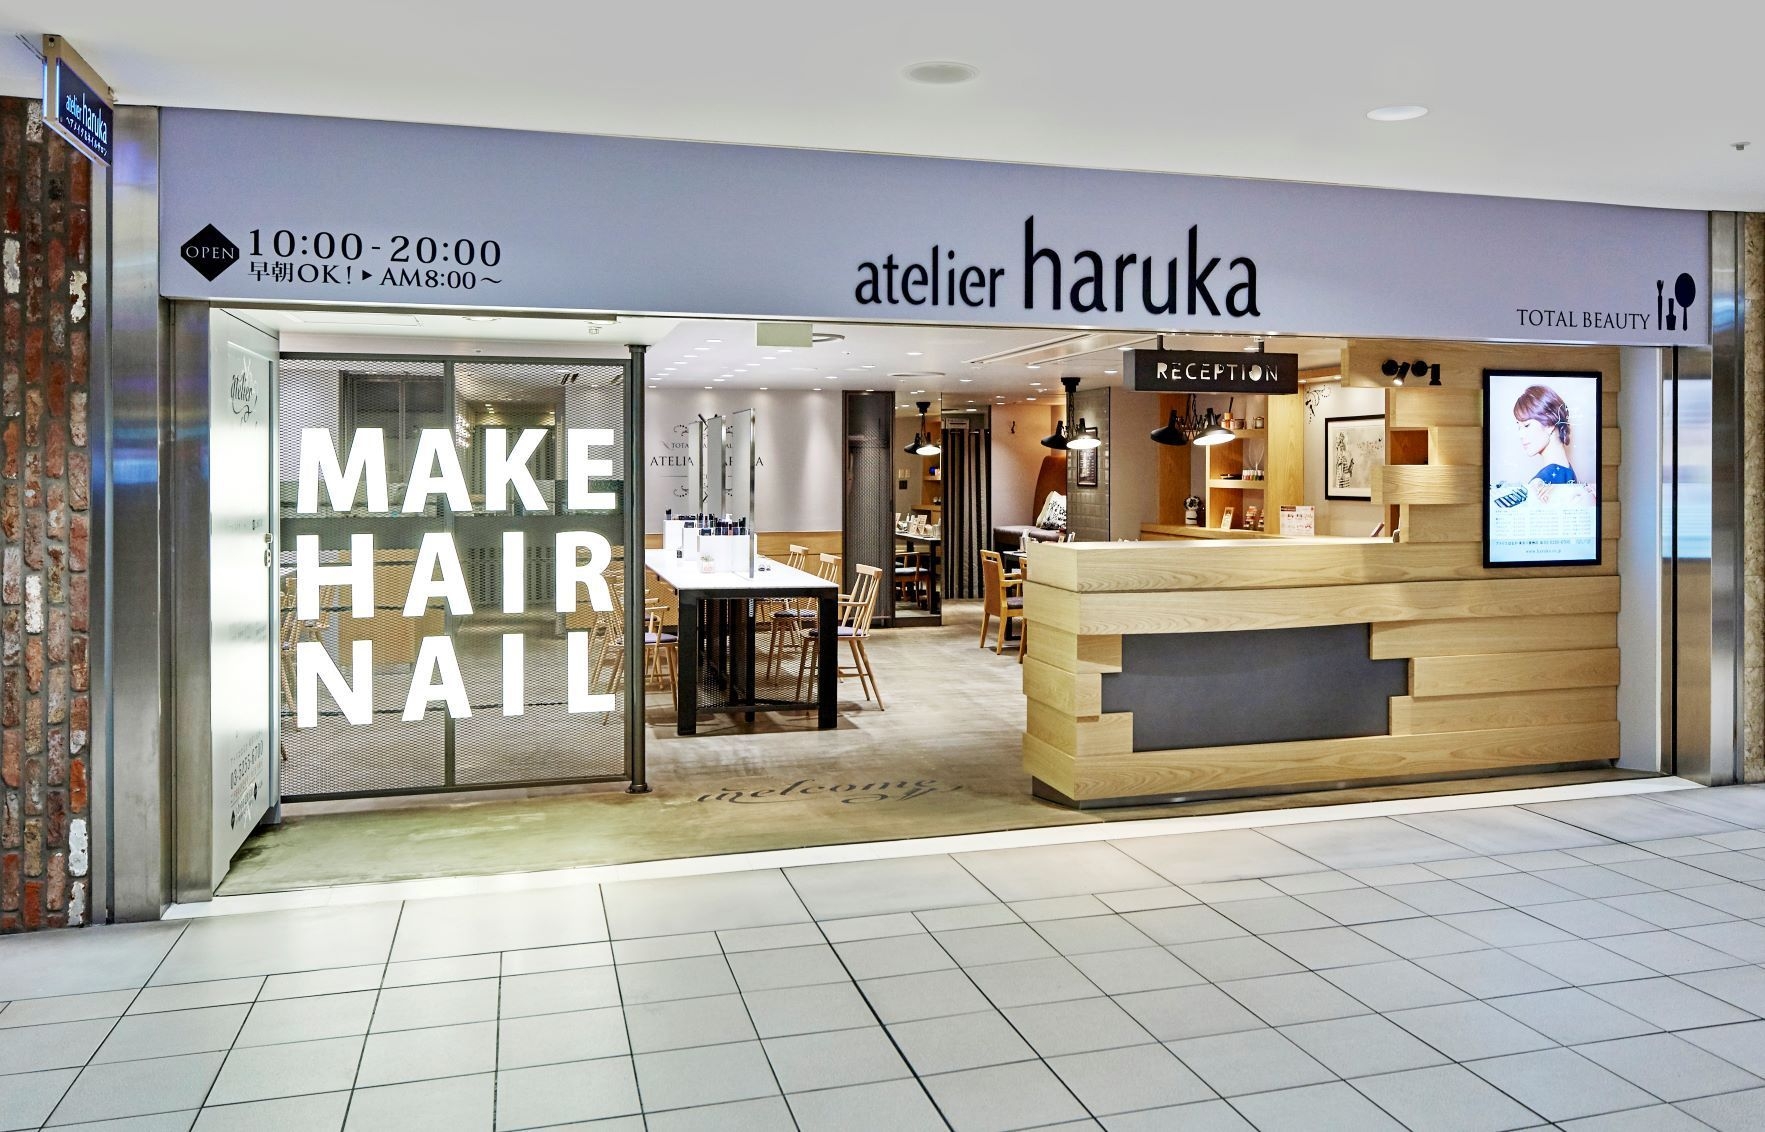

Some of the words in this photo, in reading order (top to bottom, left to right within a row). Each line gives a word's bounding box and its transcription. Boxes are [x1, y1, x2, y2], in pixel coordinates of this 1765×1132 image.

[66, 94, 82, 121] atelier
[82, 92, 107, 144] haruka
[186, 245, 235, 260] OPEN
[854, 244, 1005, 308] atelier
[1024, 214, 1261, 318] haruka
[1516, 308, 1578, 328] TOTAL
[1582, 311, 1651, 330] BEAUTY
[1156, 361, 1279, 382] RECEPTION
[296, 427, 617, 514] MAKE
[296, 530, 615, 621] HAIR
[296, 631, 617, 729] NAIL
